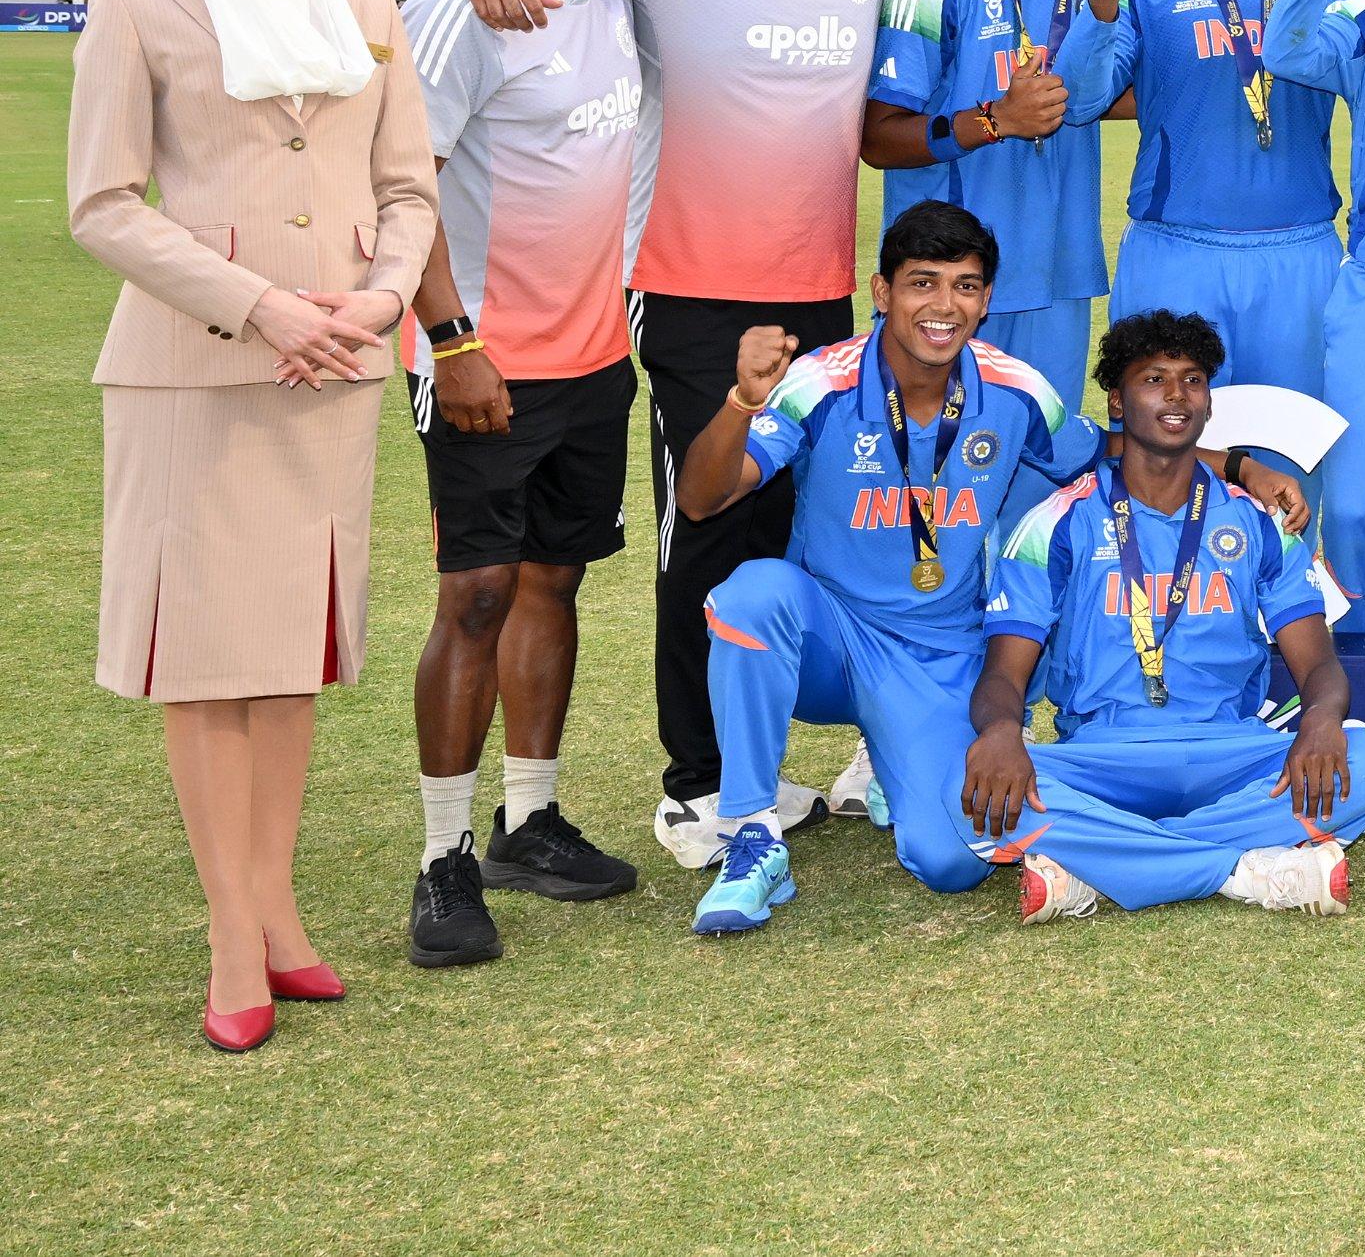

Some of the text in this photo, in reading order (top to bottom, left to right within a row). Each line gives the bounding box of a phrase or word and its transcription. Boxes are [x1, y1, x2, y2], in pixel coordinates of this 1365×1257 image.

[45, 12, 70, 23] DP
[746, 15, 858, 59] apollo
[786, 49, 855, 66] TYRES
[567, 76, 643, 136] apollo
[886, 389, 903, 432] WINNER
[972, 474, 990, 483] U-19
[850, 486, 982, 531] INDIA
[1190, 483, 1205, 521] WINNER
